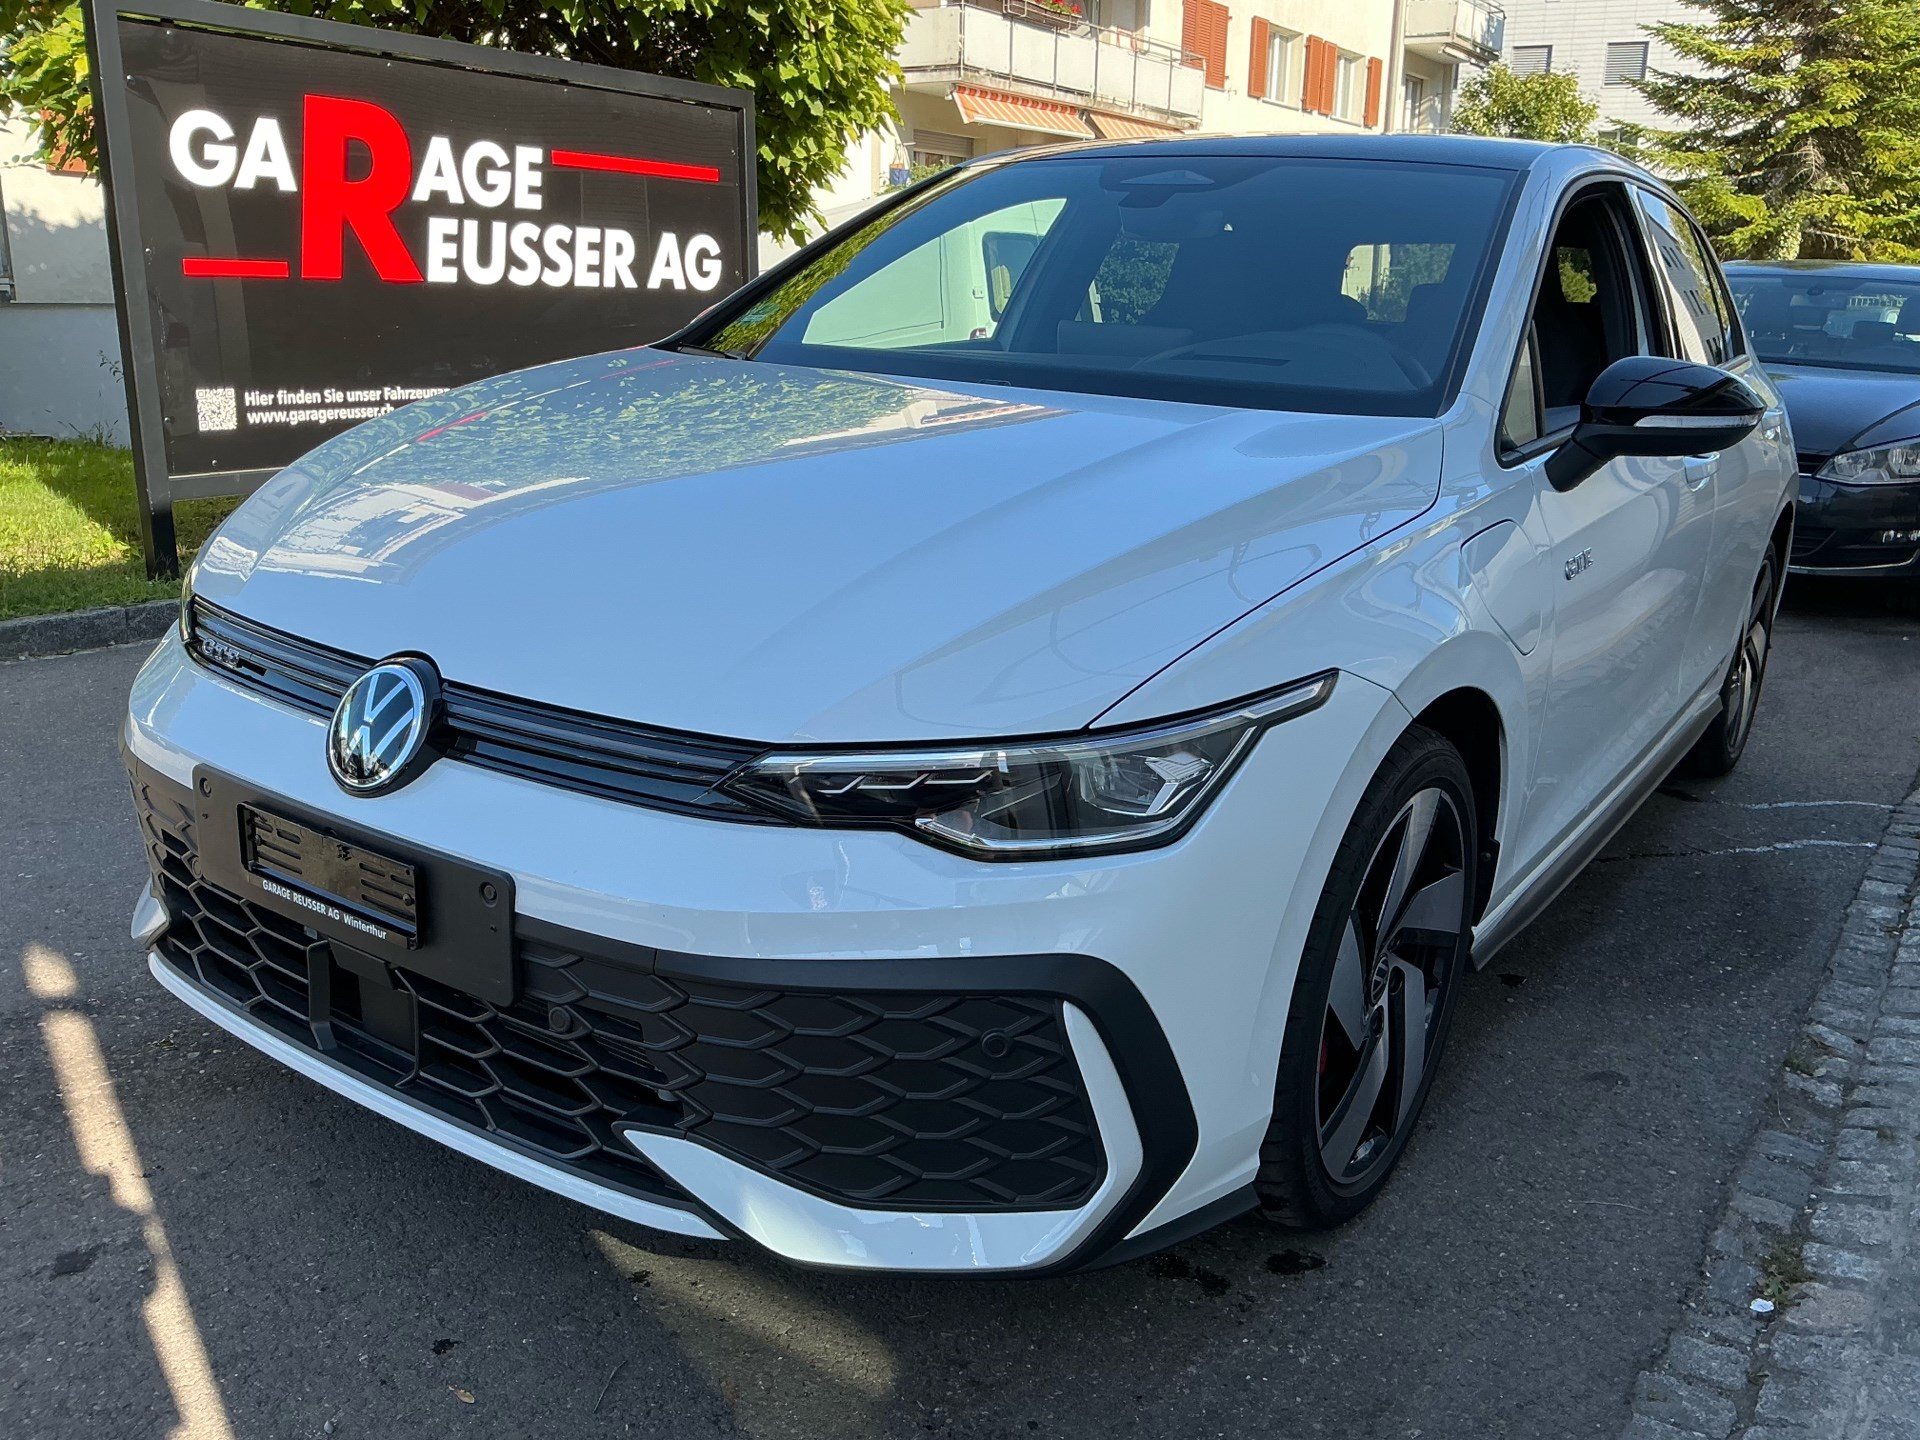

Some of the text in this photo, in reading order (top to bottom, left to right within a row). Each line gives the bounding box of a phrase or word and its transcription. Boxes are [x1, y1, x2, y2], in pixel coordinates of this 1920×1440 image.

[169, 94, 543, 283] GARAGE
[647, 231, 722, 291] AG
[244, 386, 451, 406] Hier finden Sie unser Fahrzeu
[262, 879, 387, 940] GARAGE REUSSER AG Winterthur
